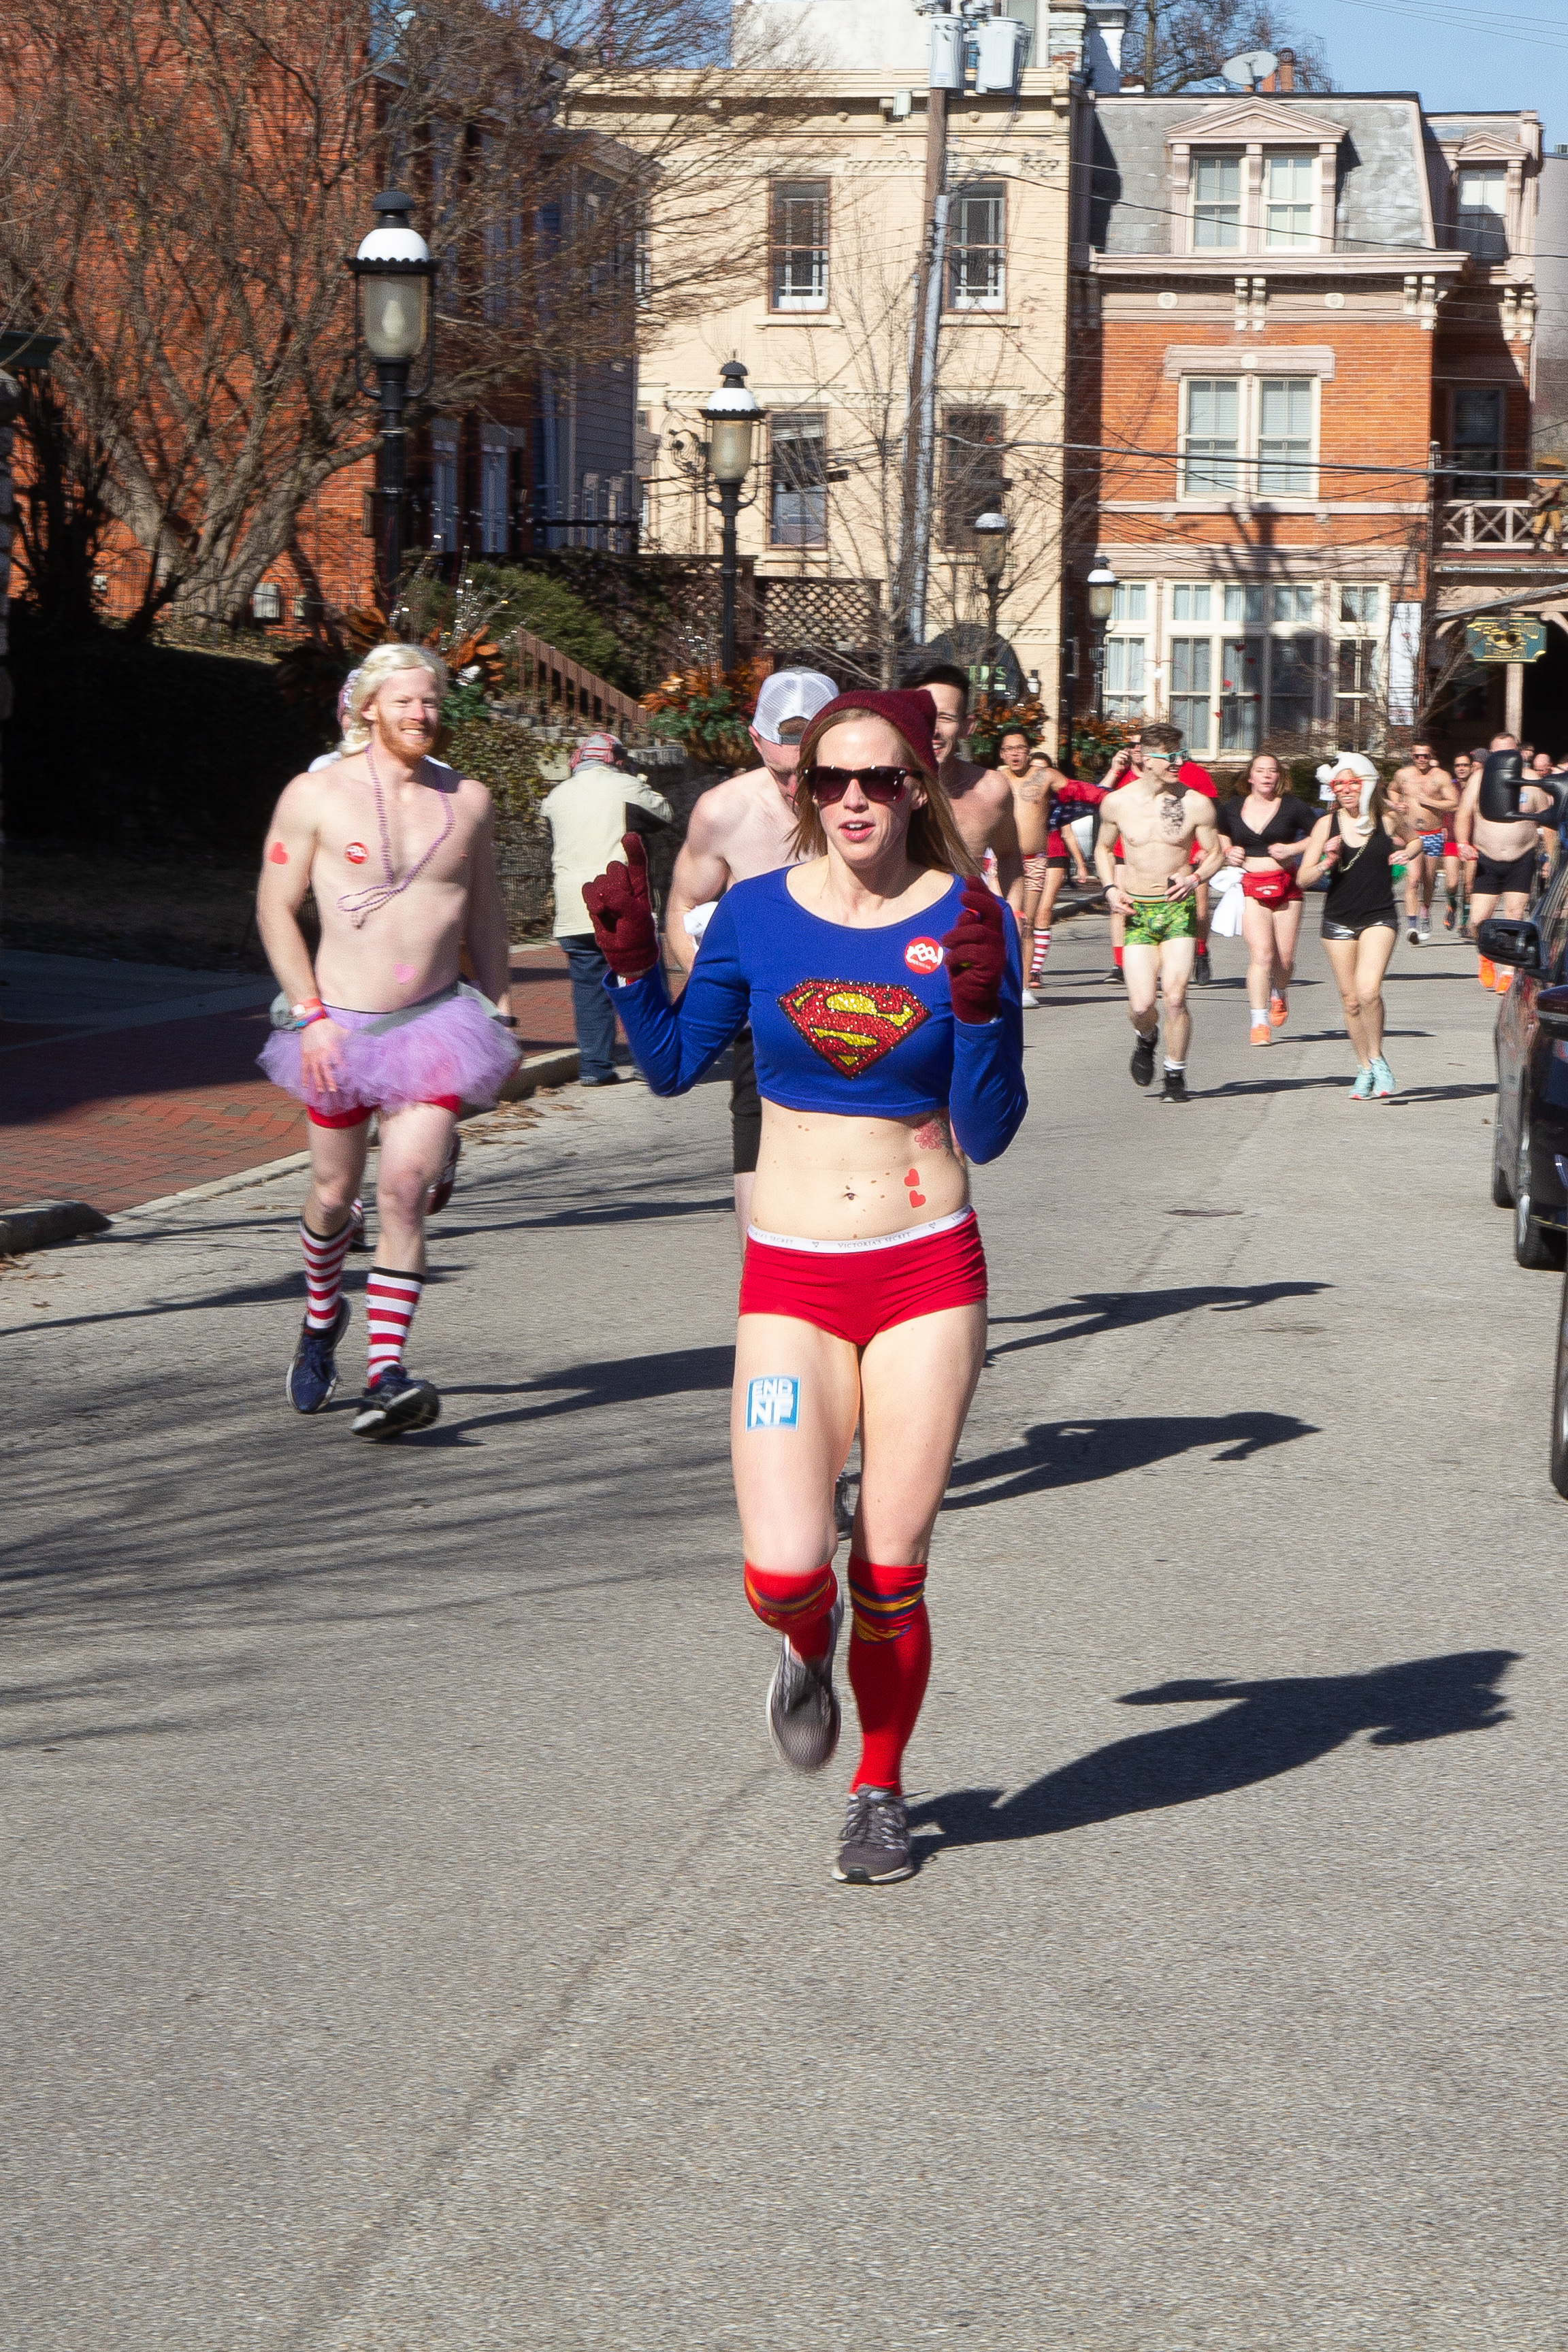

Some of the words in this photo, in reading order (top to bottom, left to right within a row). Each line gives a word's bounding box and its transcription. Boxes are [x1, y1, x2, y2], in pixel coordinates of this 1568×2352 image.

[838, 1239, 882, 1248] VICTORIA'S
[883, 1231, 911, 1242] SECRET
[752, 1378, 794, 1399] END
[751, 1396, 794, 1427] NF
